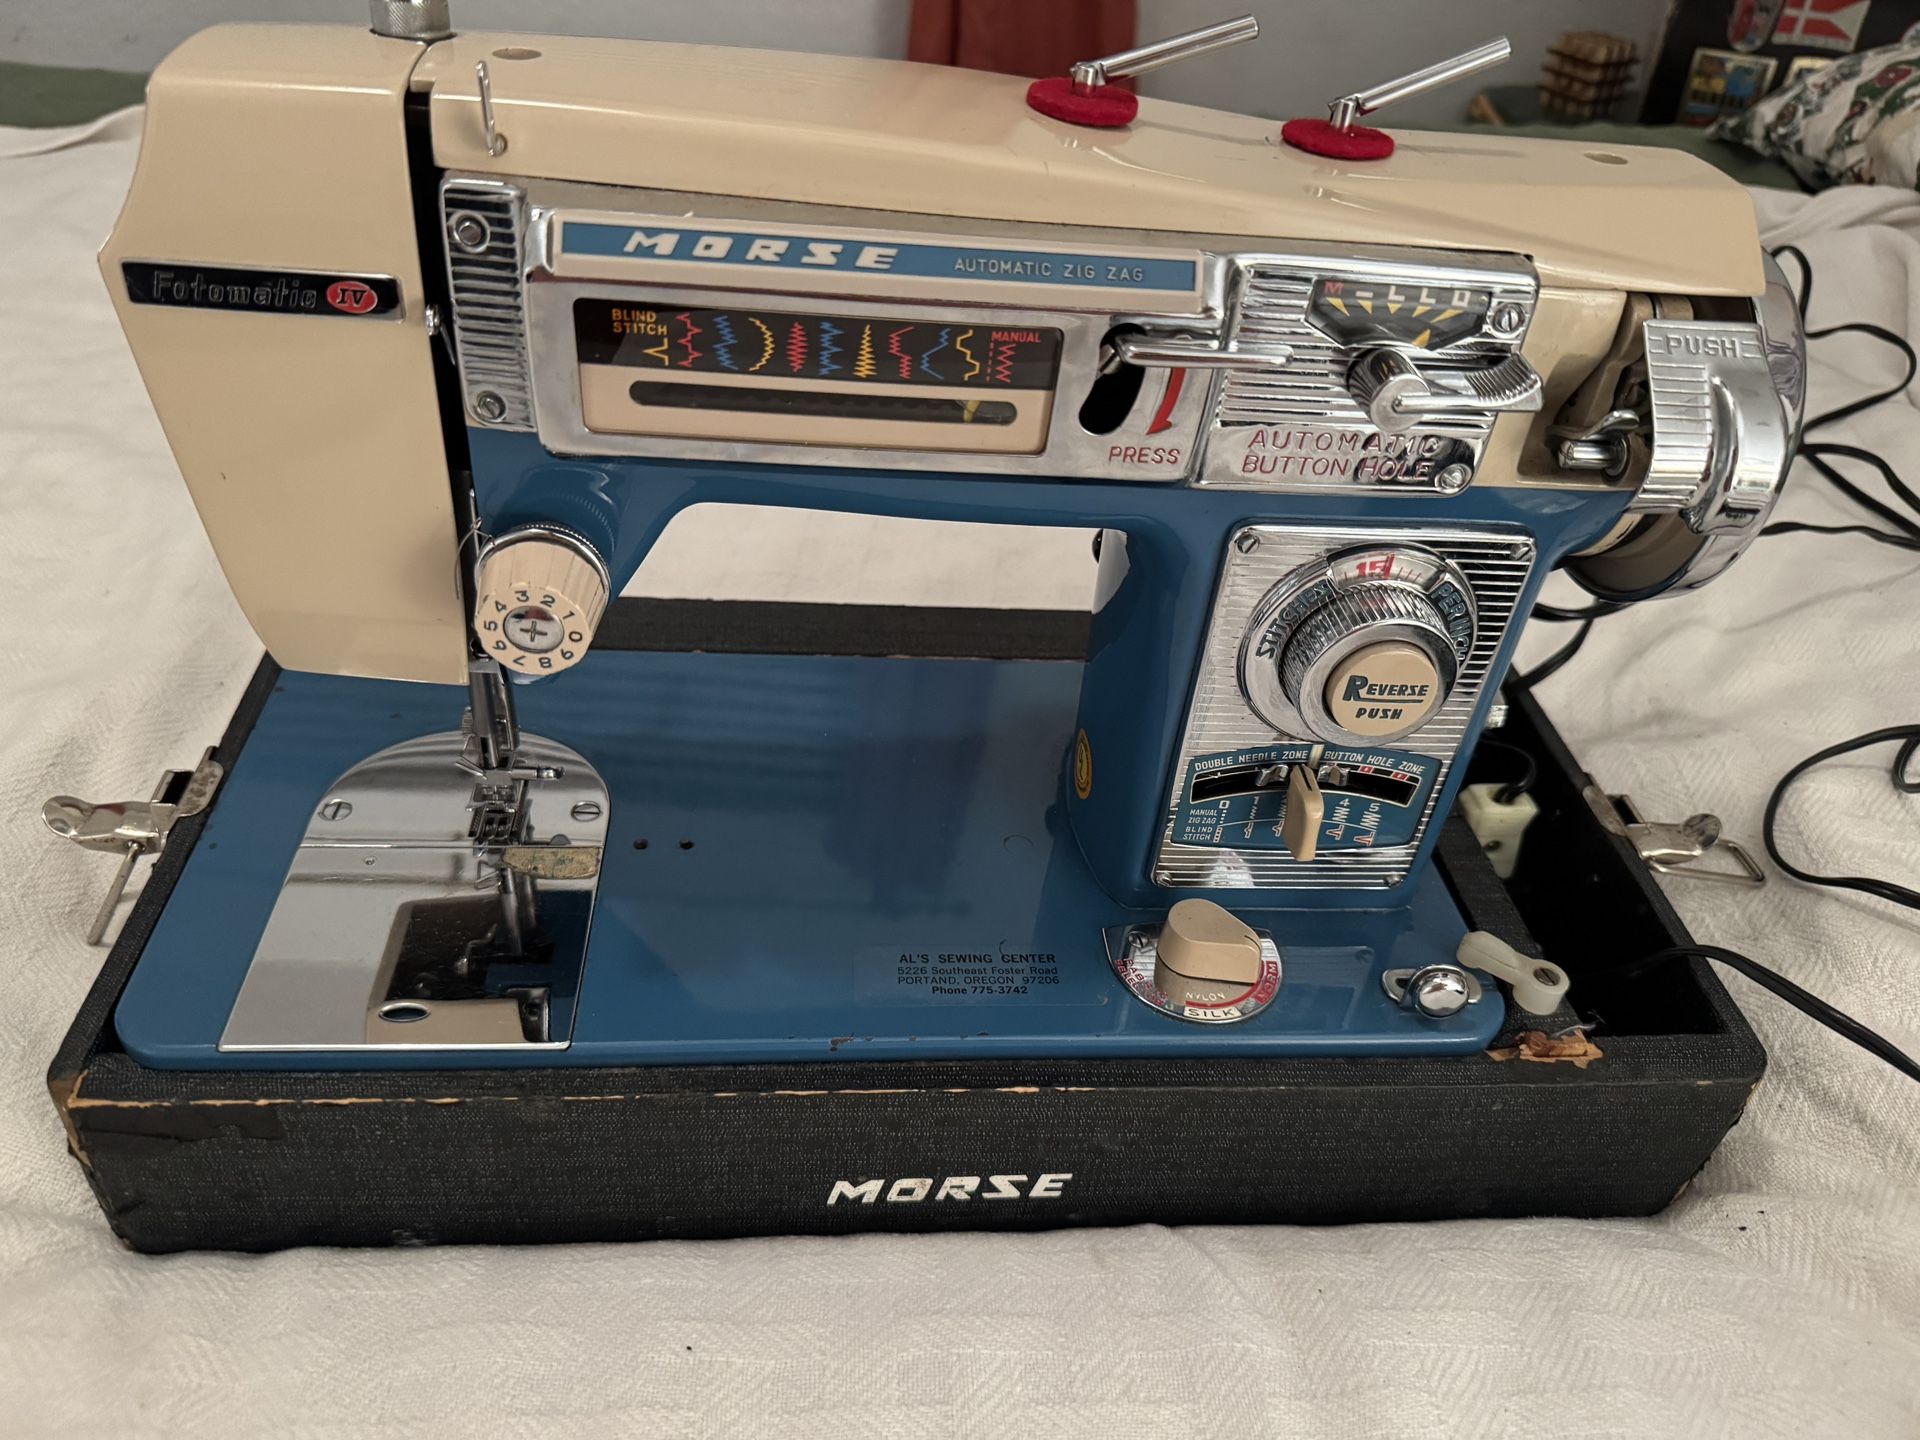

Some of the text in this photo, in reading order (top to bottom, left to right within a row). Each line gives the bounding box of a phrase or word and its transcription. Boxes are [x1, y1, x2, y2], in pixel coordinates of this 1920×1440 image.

[622, 230, 1144, 282] MORSE AUTOMATIC ZIG ZAG
[153, 270, 368, 309] Fotomatic IV
[611, 308, 657, 323] BLIND
[612, 321, 668, 337] STITCH
[991, 331, 1041, 344] MANUAL
[1665, 334, 1739, 358] PUSH
[1248, 429, 1440, 458] AUTOMATIC
[1108, 446, 1181, 465] PRESS
[1241, 454, 1436, 481] BUTTON HOLE
[1431, 582, 1467, 621] PER
[1449, 616, 1472, 661] INCH
[483, 590, 583, 669] 0 1 2 3 4 5 6 7 8 9
[1341, 674, 1430, 702] REVERSE
[1354, 707, 1404, 720] PUSH
[1194, 750, 1309, 772] DOUBLE NEEDLE ZONE
[1323, 751, 1427, 776] BUTTON HOLE ZONE
[1189, 808, 1218, 816] MANUAL
[1339, 798, 1350, 807] 4
[1368, 802, 1381, 812] 5
[1187, 816, 1217, 824] ZIG ZAG
[1185, 825, 1213, 833] BLIND
[1182, 833, 1211, 841] STITCH
[899, 953, 1056, 964] AL'S SEWING CENTER
[897, 966, 1058, 975] 5226 Southeast Foster Road
[898, 976, 1060, 986] PORTAND, OREGON 97206
[932, 986, 1028, 995] Phone 775-3742
[1185, 990, 1226, 1001] NYLON
[1188, 1007, 1236, 1018] SILK
[826, 1173, 1074, 1205] MORSE
